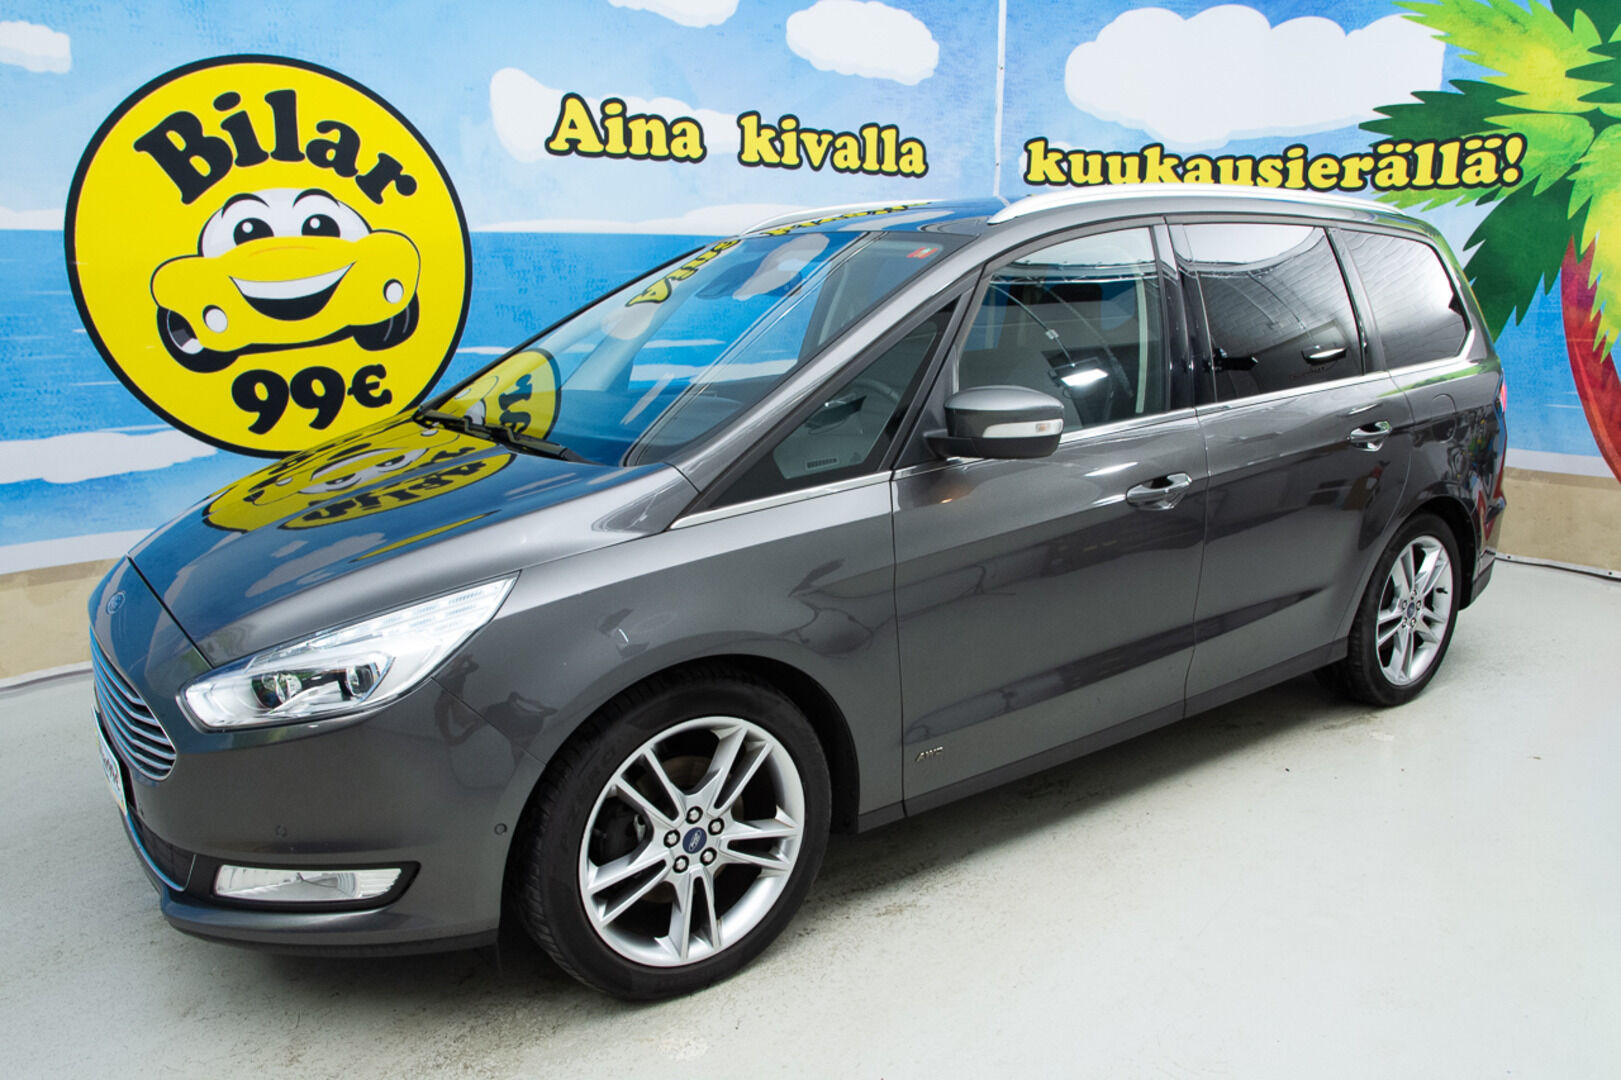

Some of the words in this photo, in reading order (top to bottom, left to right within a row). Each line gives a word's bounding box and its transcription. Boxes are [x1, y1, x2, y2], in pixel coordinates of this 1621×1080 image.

[134, 89, 418, 205] Bilar
[546, 93, 706, 163] Aina
[737, 110, 928, 178] kivalla
[1023, 133, 1527, 193] kuukausierällä!
[232, 364, 393, 435] 99€
